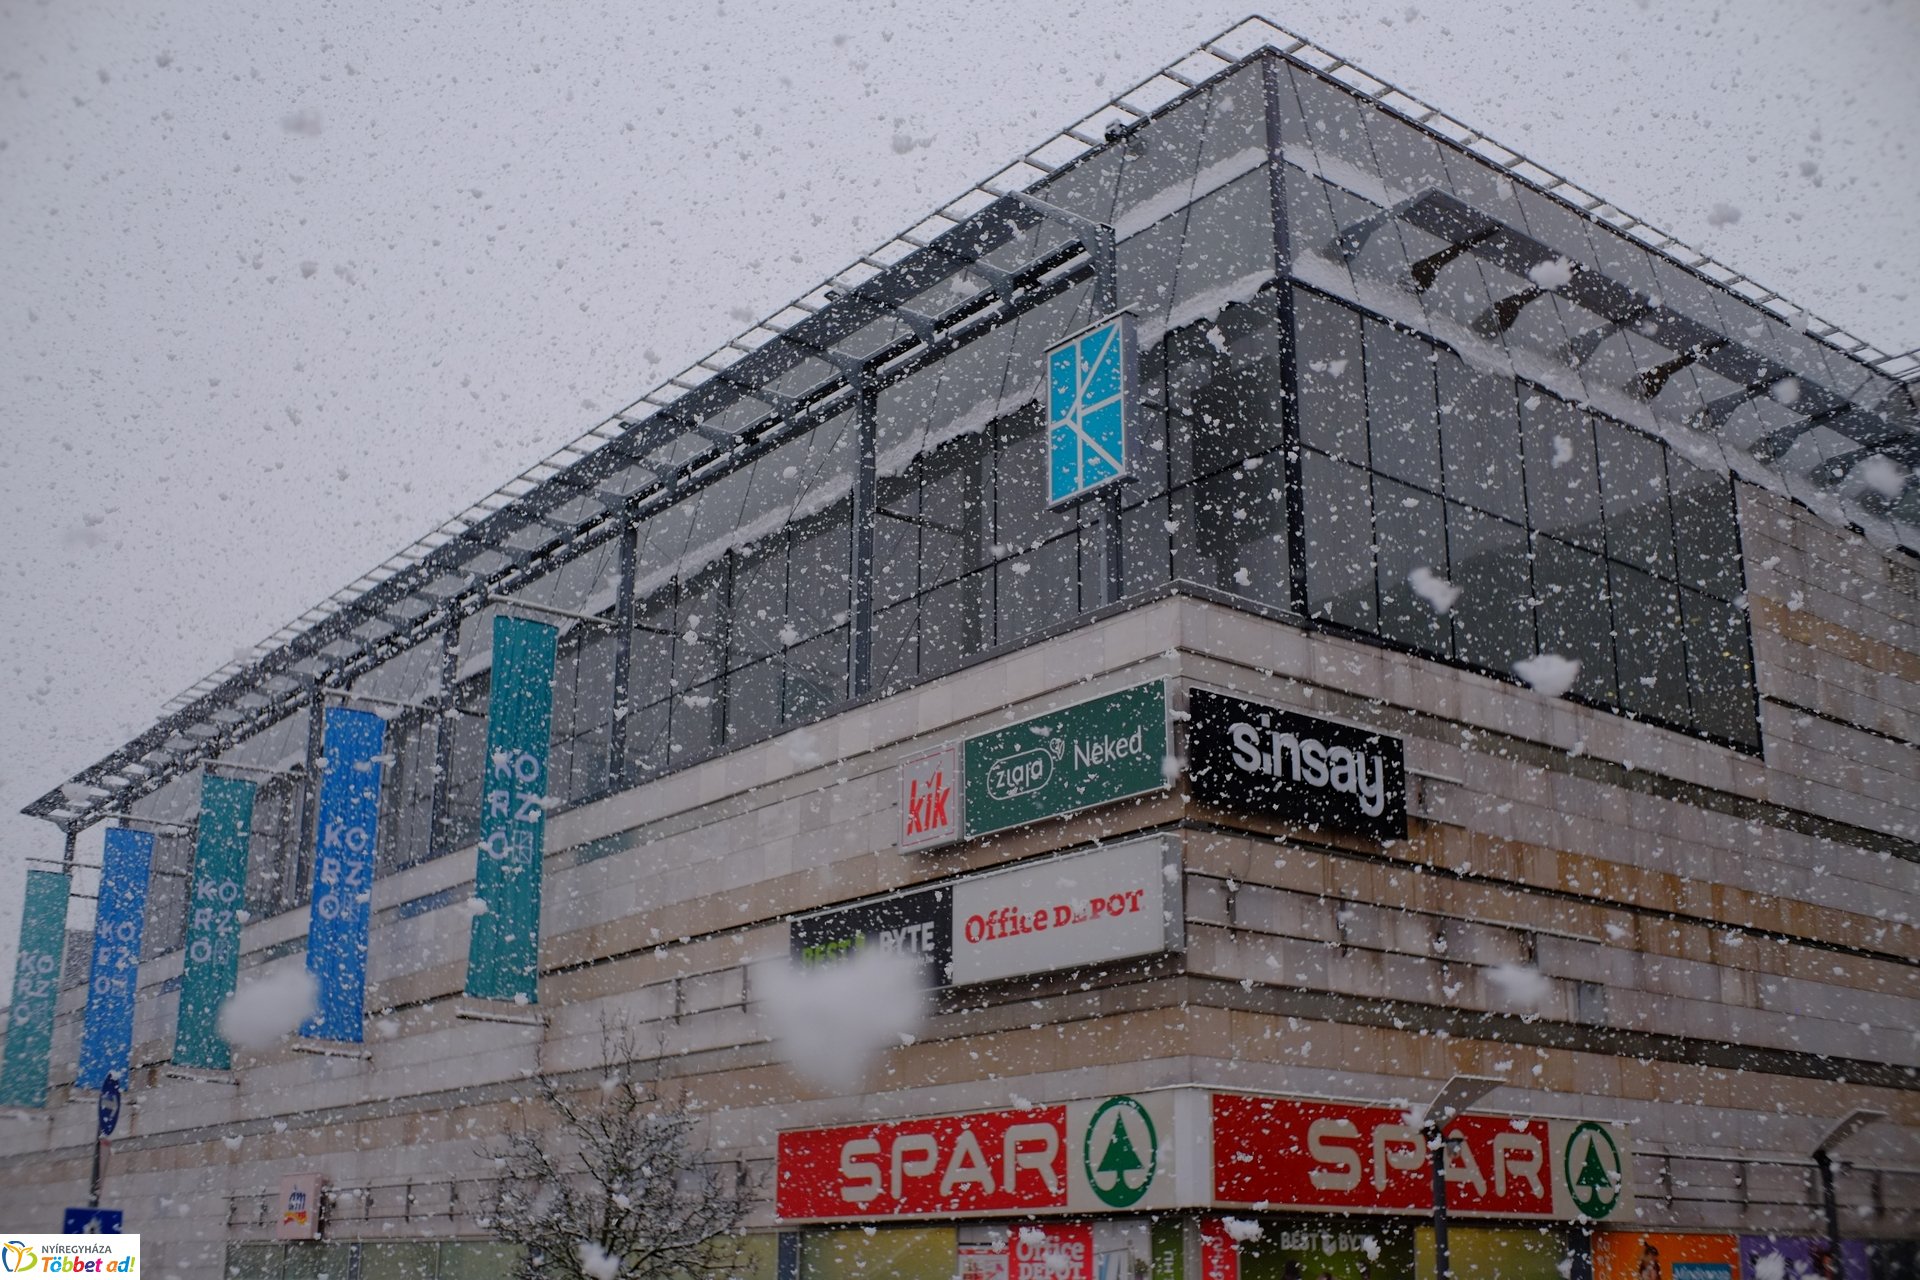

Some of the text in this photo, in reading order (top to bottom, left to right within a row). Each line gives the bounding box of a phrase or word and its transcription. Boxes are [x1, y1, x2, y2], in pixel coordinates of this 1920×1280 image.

[1074, 725, 1143, 770] Neked
[493, 748, 539, 782] KO
[1228, 714, 1385, 817] sinsay
[490, 790, 540, 821] RZ
[324, 823, 367, 852] KO
[321, 857, 364, 886] RZ
[197, 879, 238, 903] KO
[99, 920, 136, 942] KO
[194, 908, 233, 932] RZ
[965, 905, 1048, 945] Office
[877, 921, 935, 953] BYTE
[20, 950, 54, 974] KO
[840, 1122, 1059, 1202] SPAR
[1307, 1117, 1544, 1199] SPAR
[1280, 1231, 1375, 1252] BEST BYT
